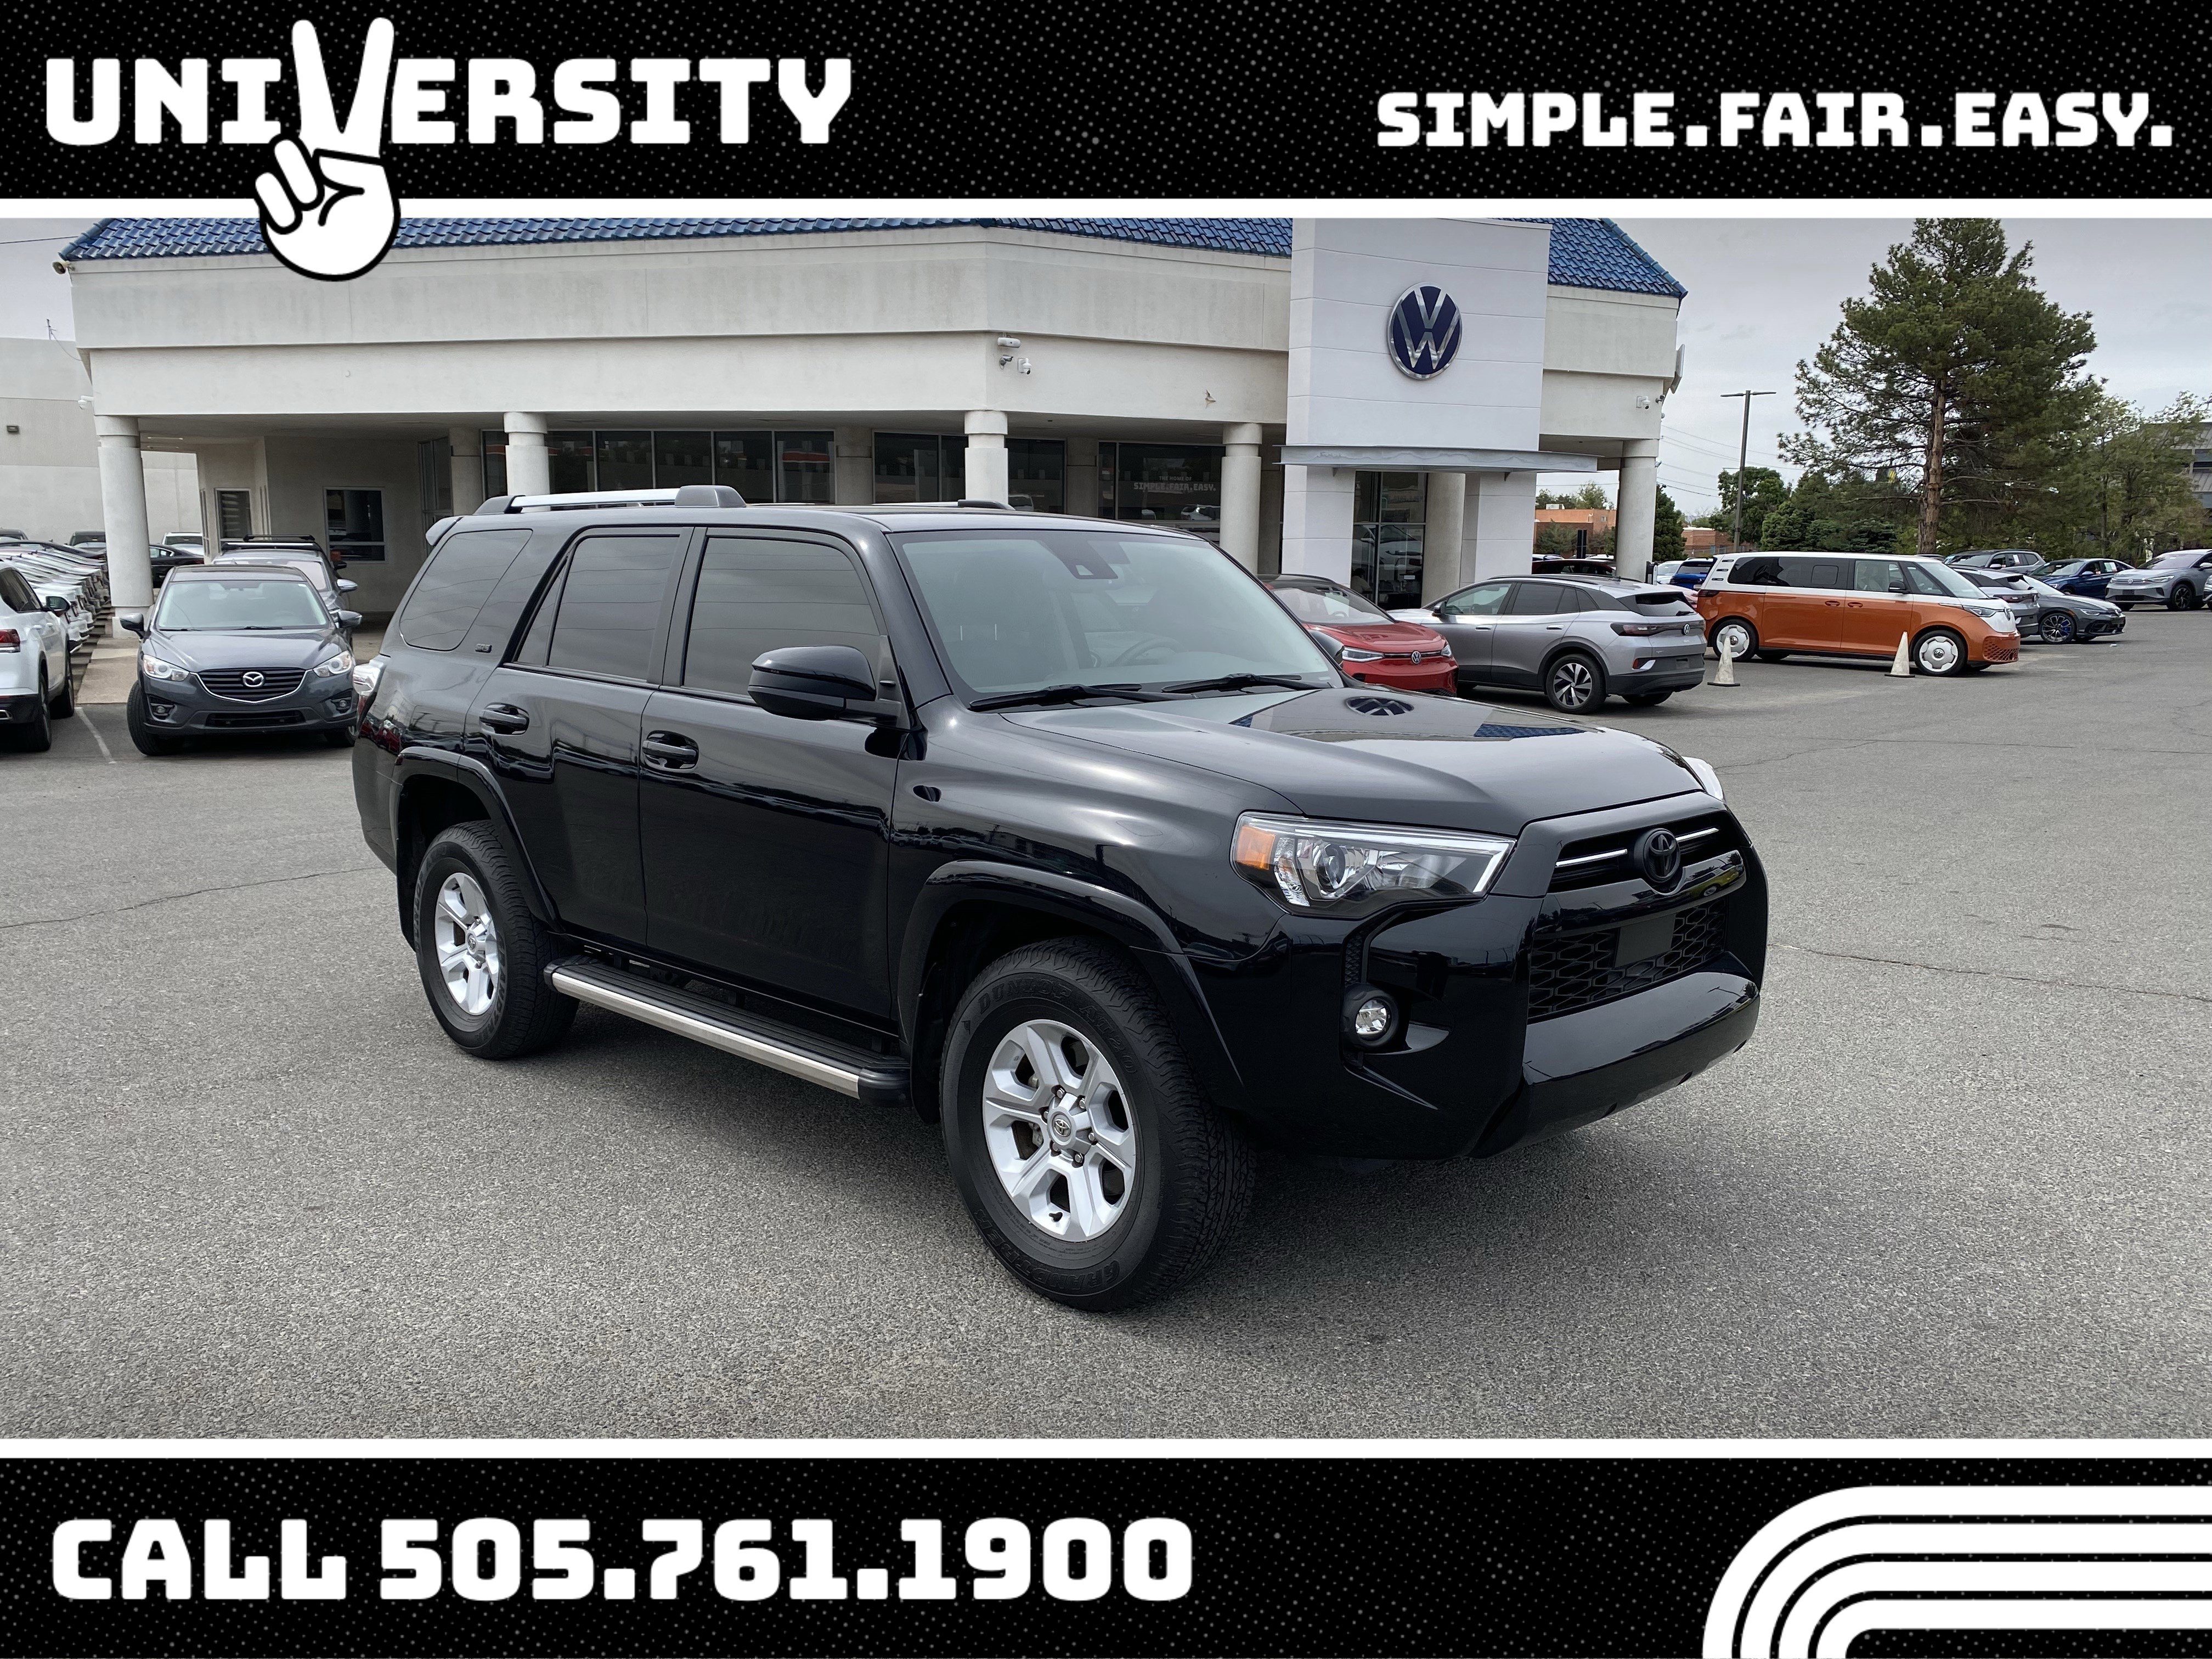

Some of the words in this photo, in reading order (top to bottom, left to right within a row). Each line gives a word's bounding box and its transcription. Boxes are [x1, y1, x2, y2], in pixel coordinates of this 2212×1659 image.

[1396, 286, 1461, 371] VW
[978, 977, 1073, 1015] DUNLOP
[1079, 1005, 1137, 1074] AT20
[973, 1208, 1120, 1290] GRANDTREK
